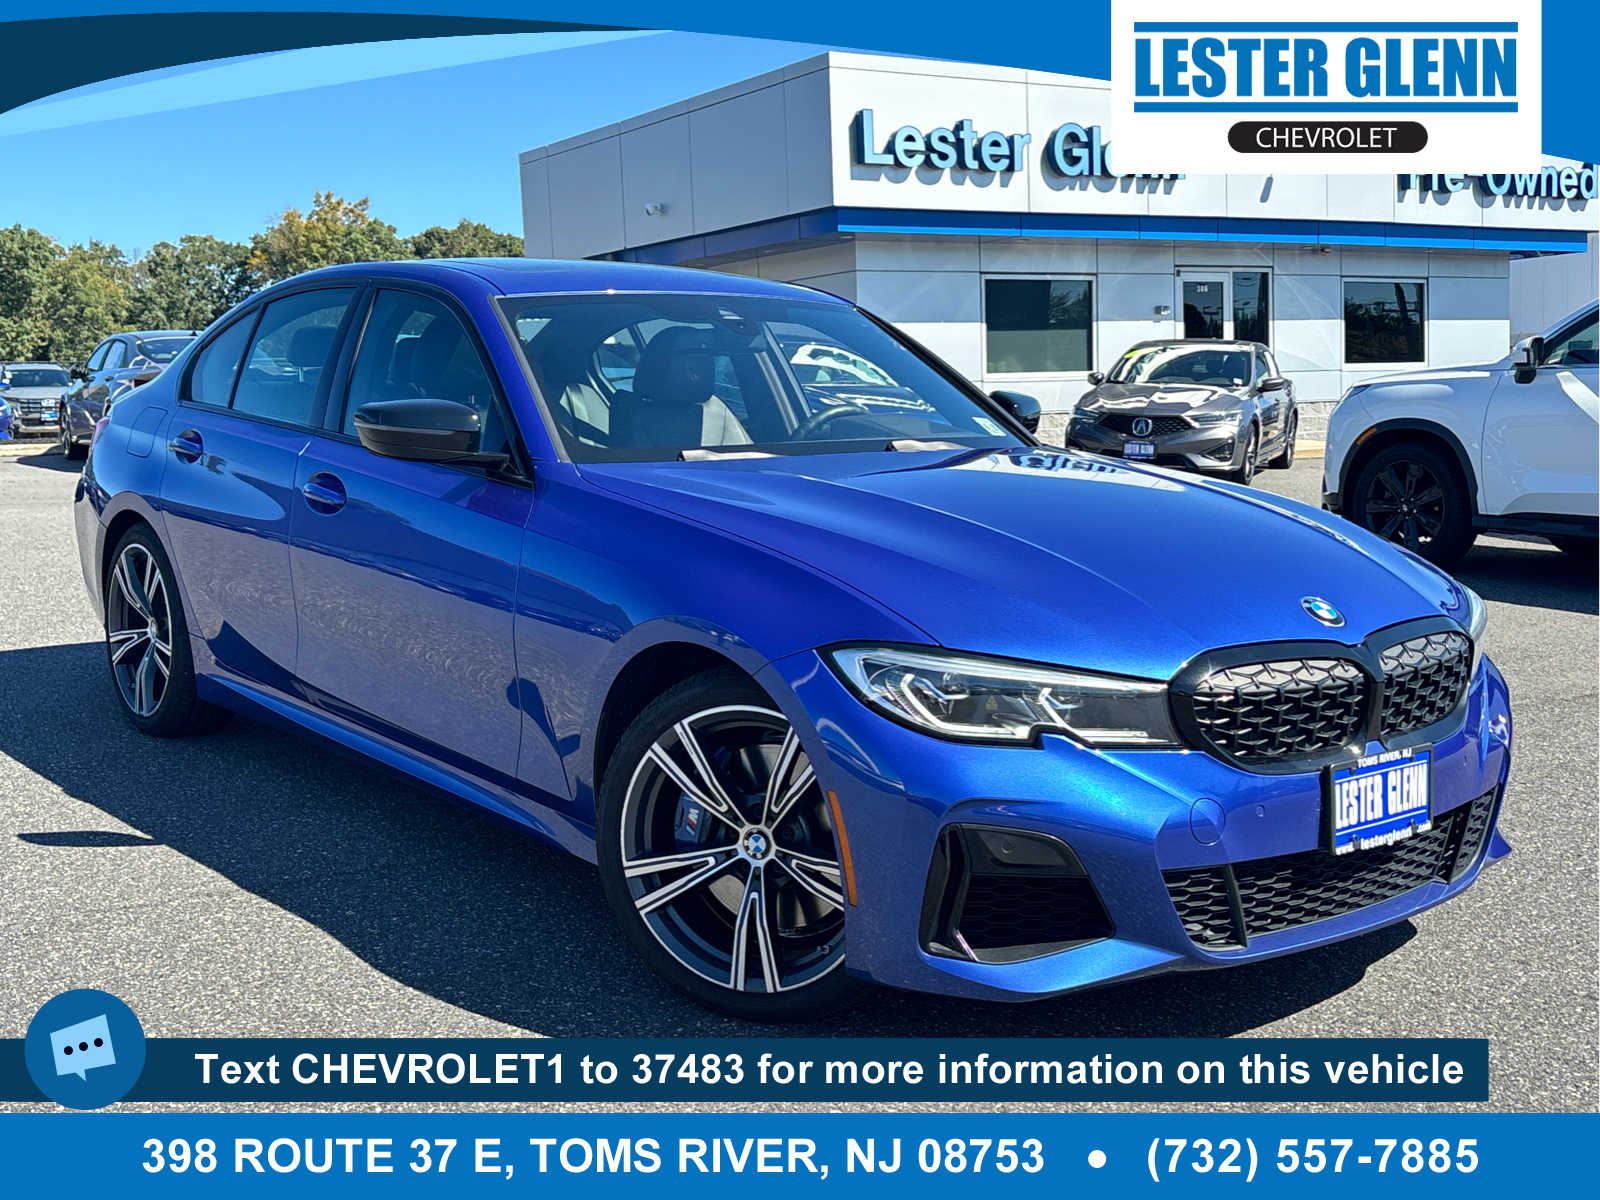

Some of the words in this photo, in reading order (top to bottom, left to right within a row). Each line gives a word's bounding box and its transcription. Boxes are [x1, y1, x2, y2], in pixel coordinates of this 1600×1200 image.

[857, 108, 1031, 172] Lester
[1358, 755, 1378, 768] TOMS
[1335, 774, 1383, 829] LESTER
[1387, 763, 1427, 815] GLENN
